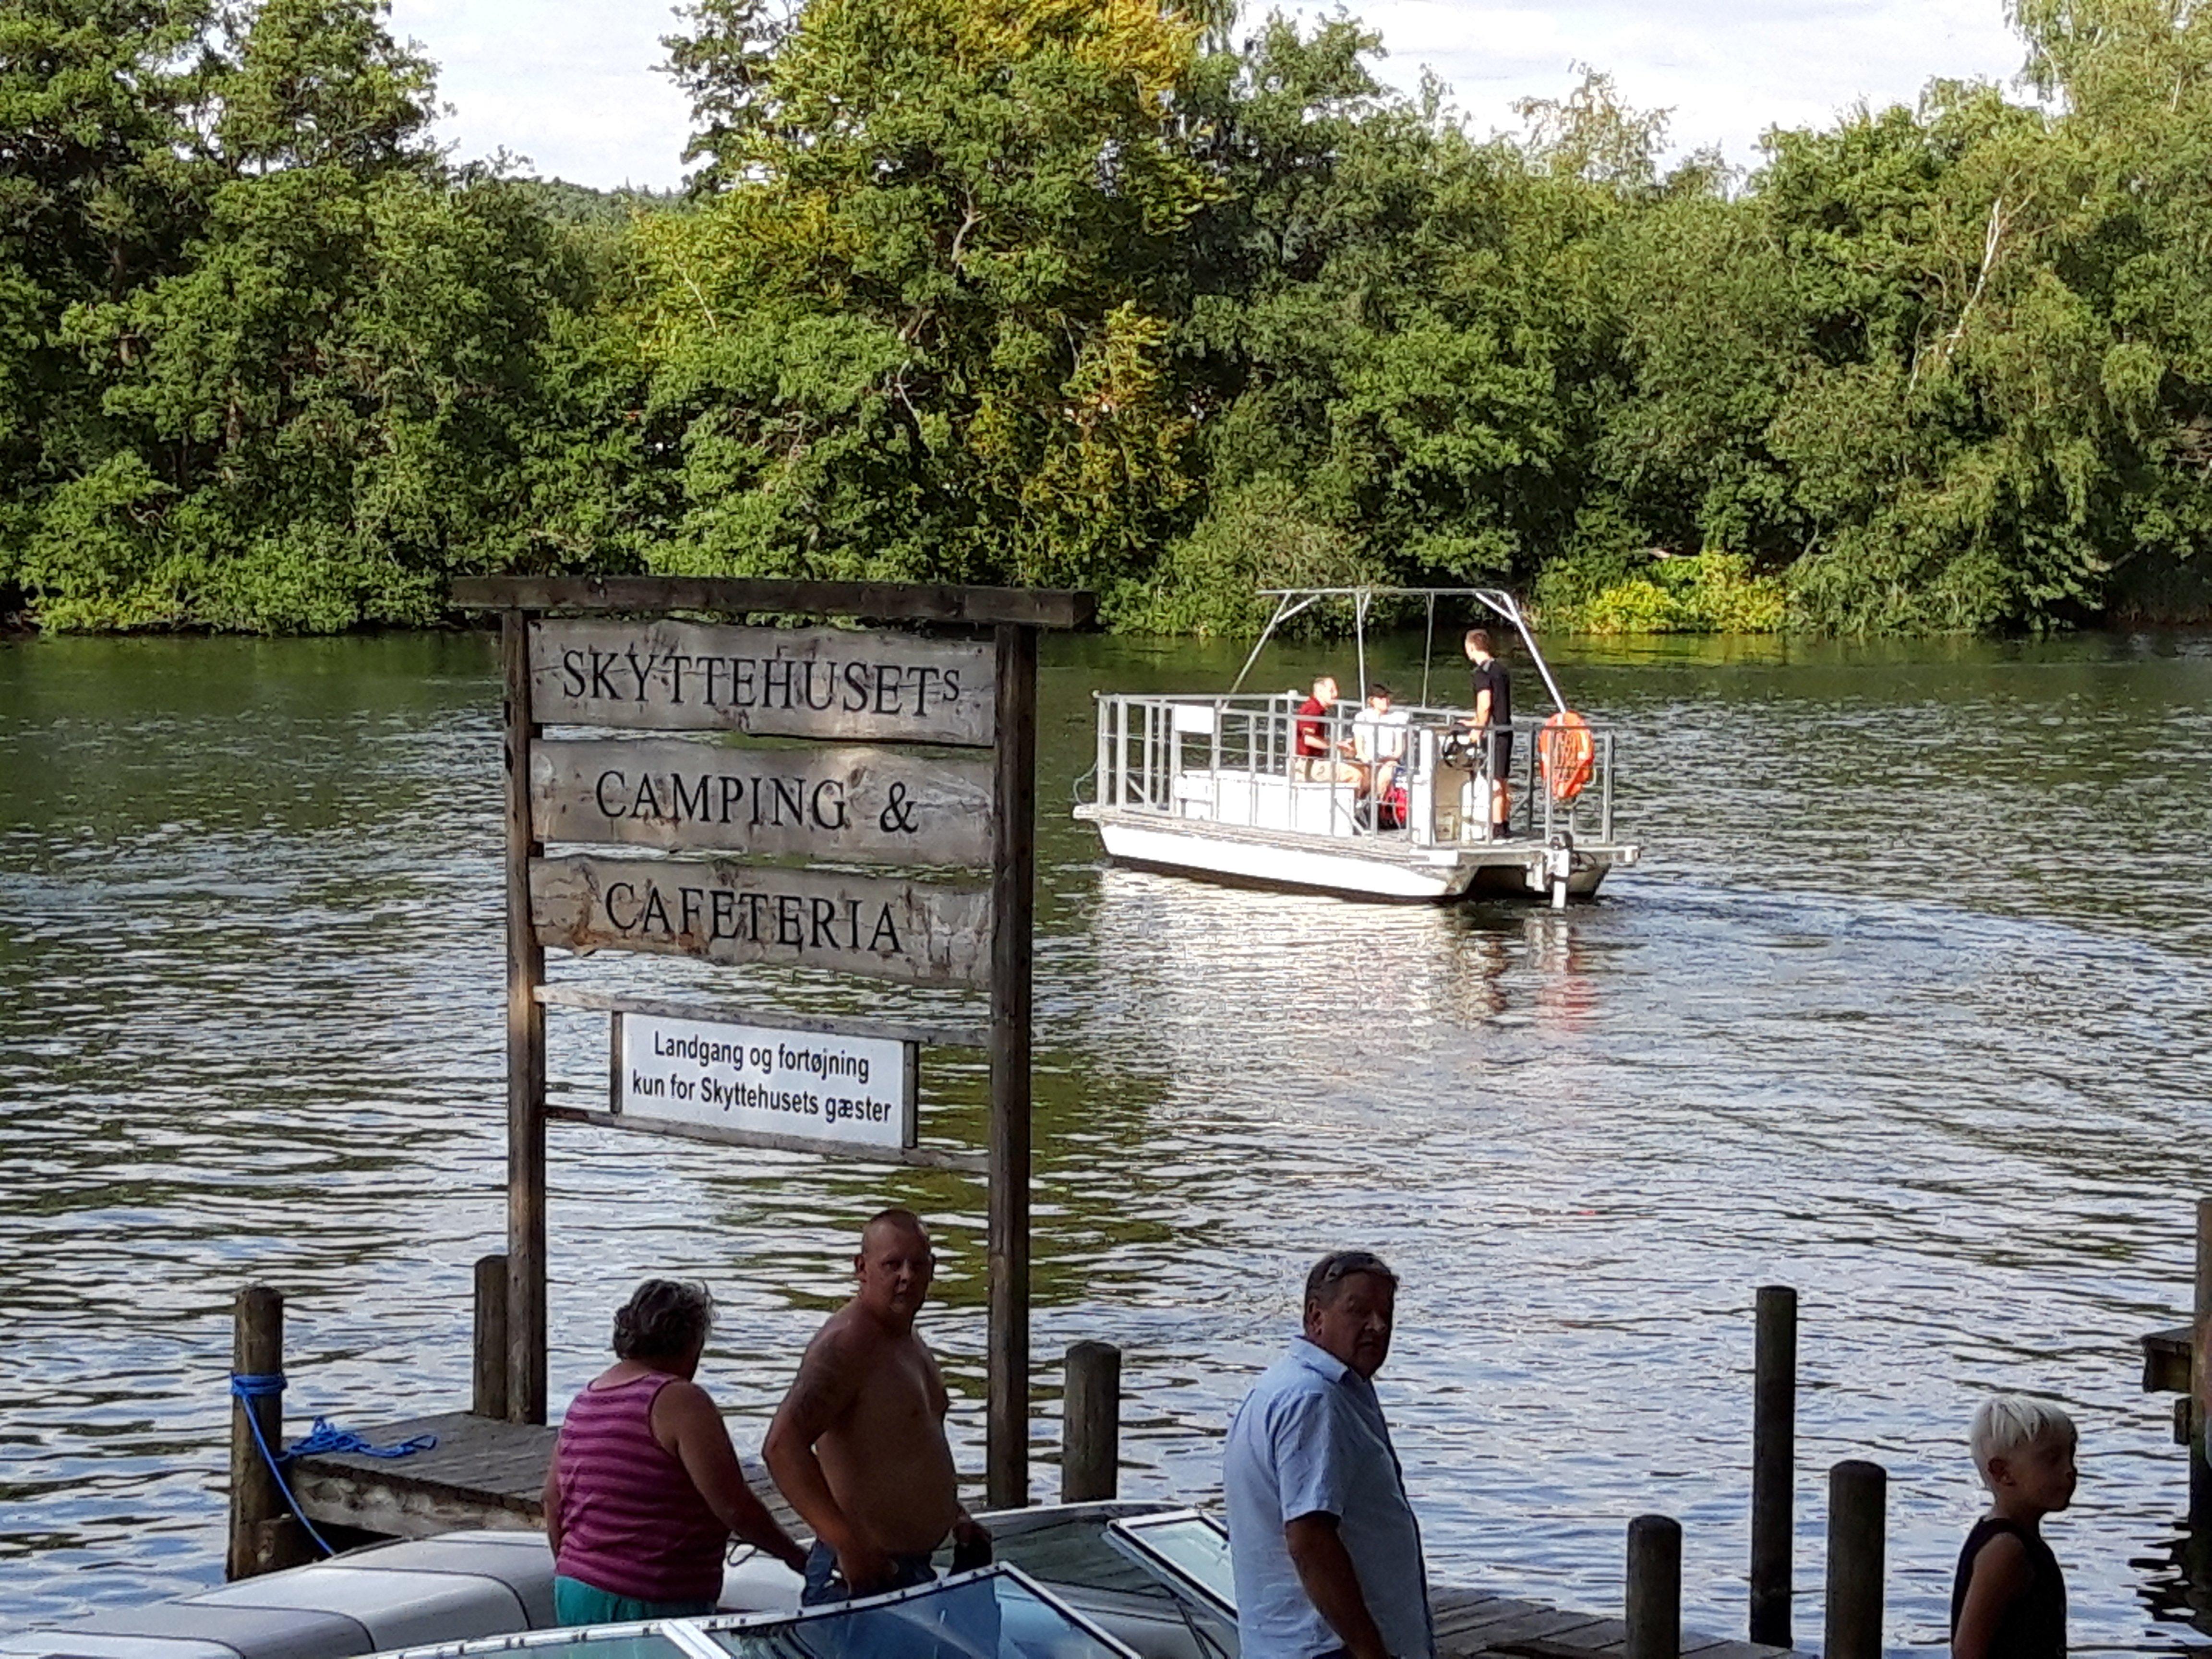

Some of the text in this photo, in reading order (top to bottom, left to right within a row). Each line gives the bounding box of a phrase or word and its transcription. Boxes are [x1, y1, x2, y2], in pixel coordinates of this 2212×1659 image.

[563, 649, 960, 717] SKYTTEHUSETS
[596, 770, 918, 834] CAMPING &
[605, 882, 903, 953] CAFETERIA
[654, 1031, 869, 1084] Landgang og fortøjning
[633, 1069, 891, 1123] kun for Skyttehusets gæster
